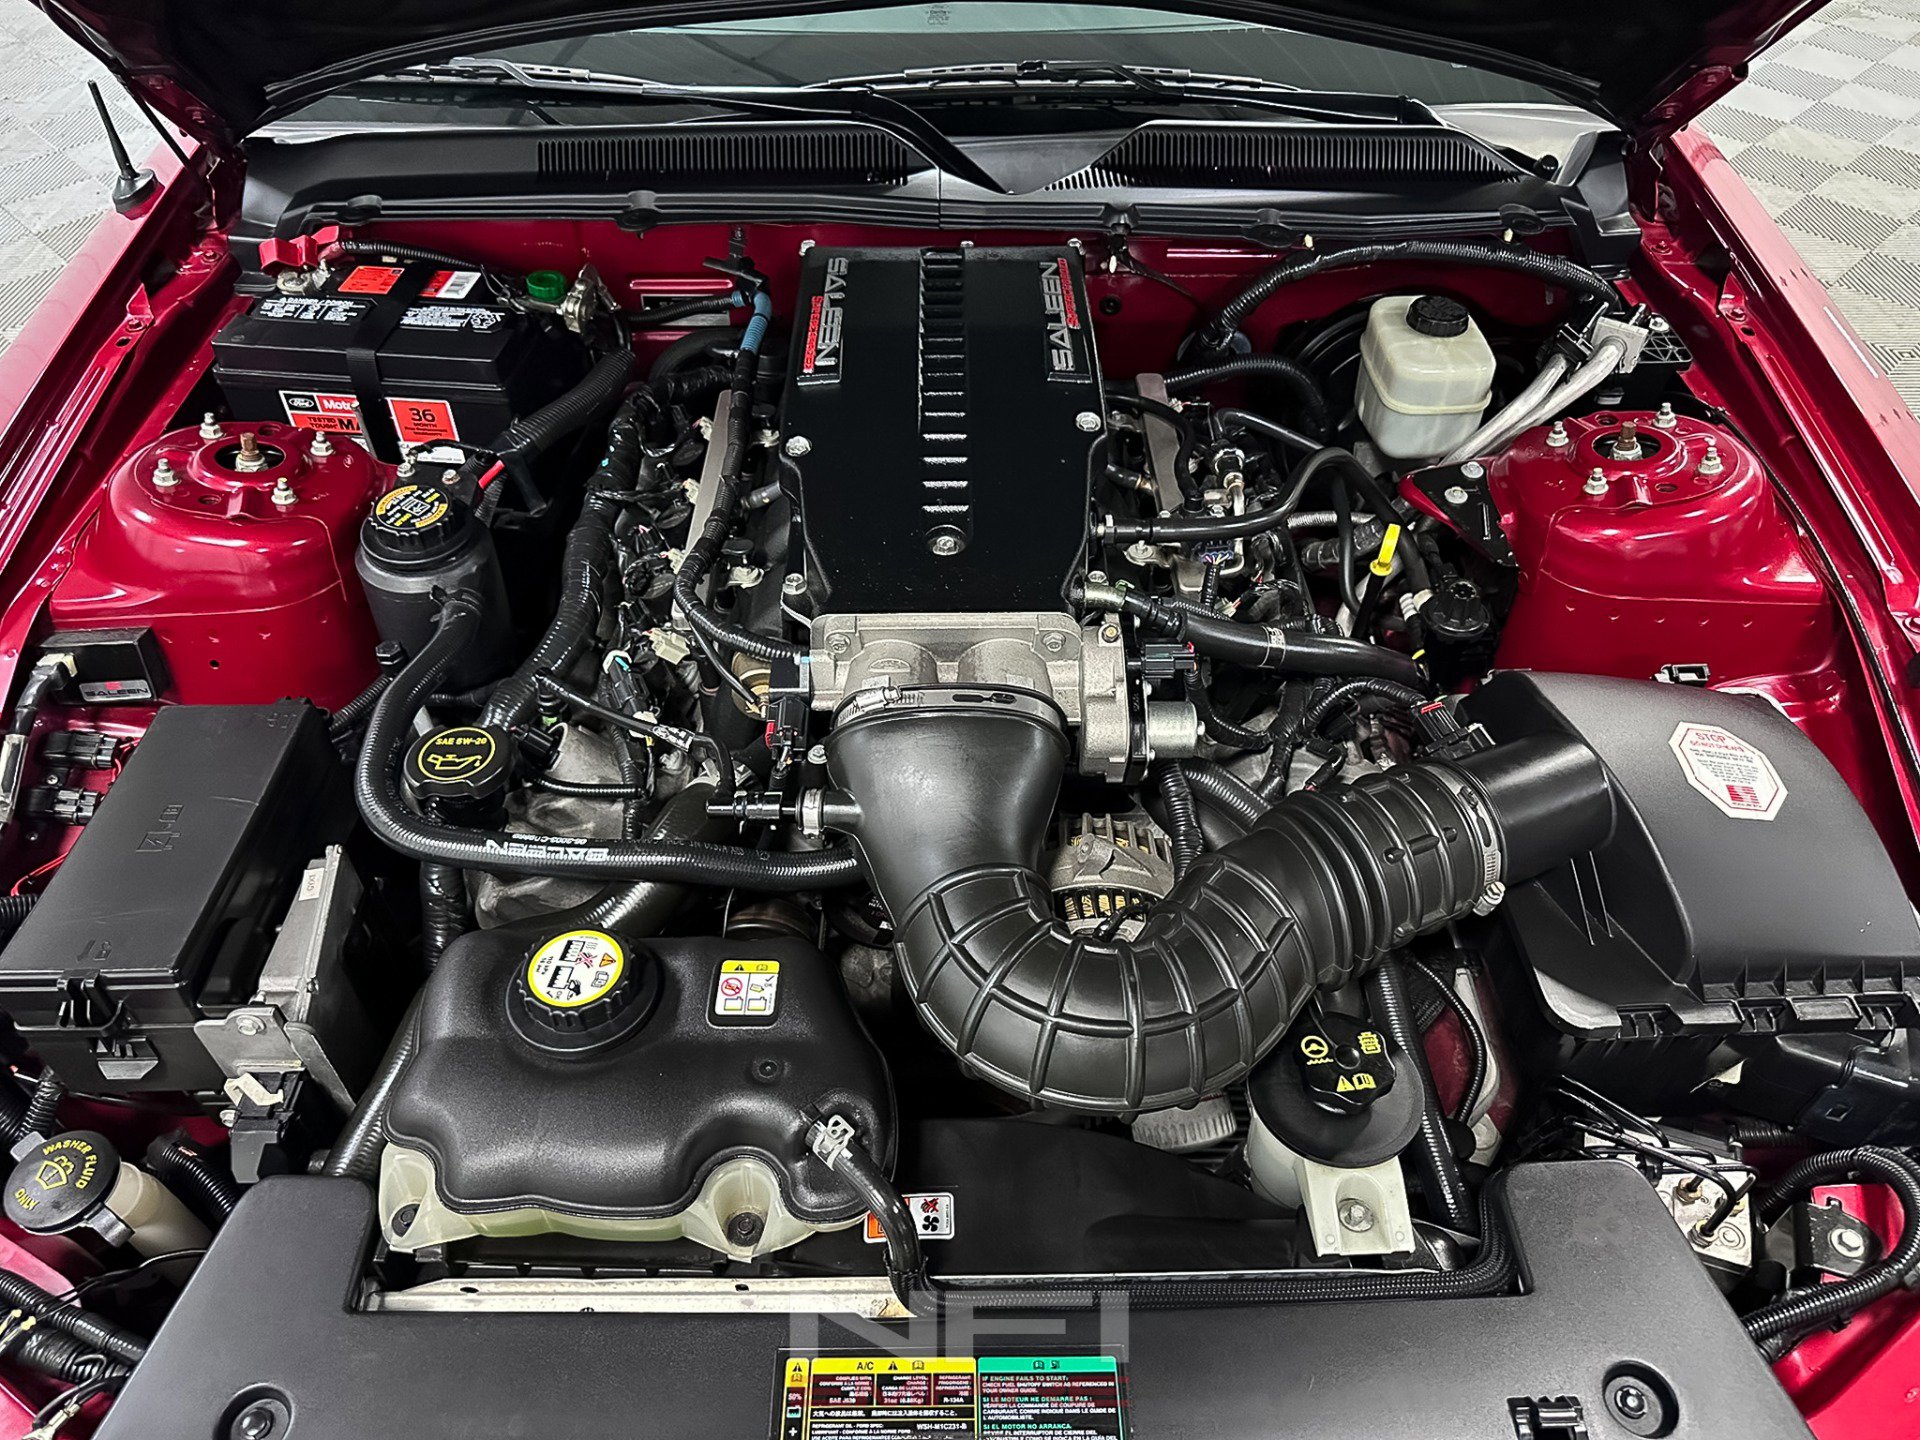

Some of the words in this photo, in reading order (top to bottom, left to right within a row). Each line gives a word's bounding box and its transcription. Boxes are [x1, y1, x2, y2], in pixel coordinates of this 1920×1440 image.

[815, 257, 848, 366] SALEEN
[1040, 261, 1076, 371] SALEEN
[409, 407, 436, 422] 36
[84, 687, 149, 697] SALEEN
[435, 737, 455, 745] SAE
[456, 737, 487, 745] 5W-20
[1695, 732, 1726, 743] STOP
[486, 839, 609, 862] SALEEN
[42, 1140, 92, 1155] WASHER
[75, 1154, 97, 1189] FLUID
[15, 1188, 39, 1211] ONLY
[856, 1361, 875, 1370] A/C
